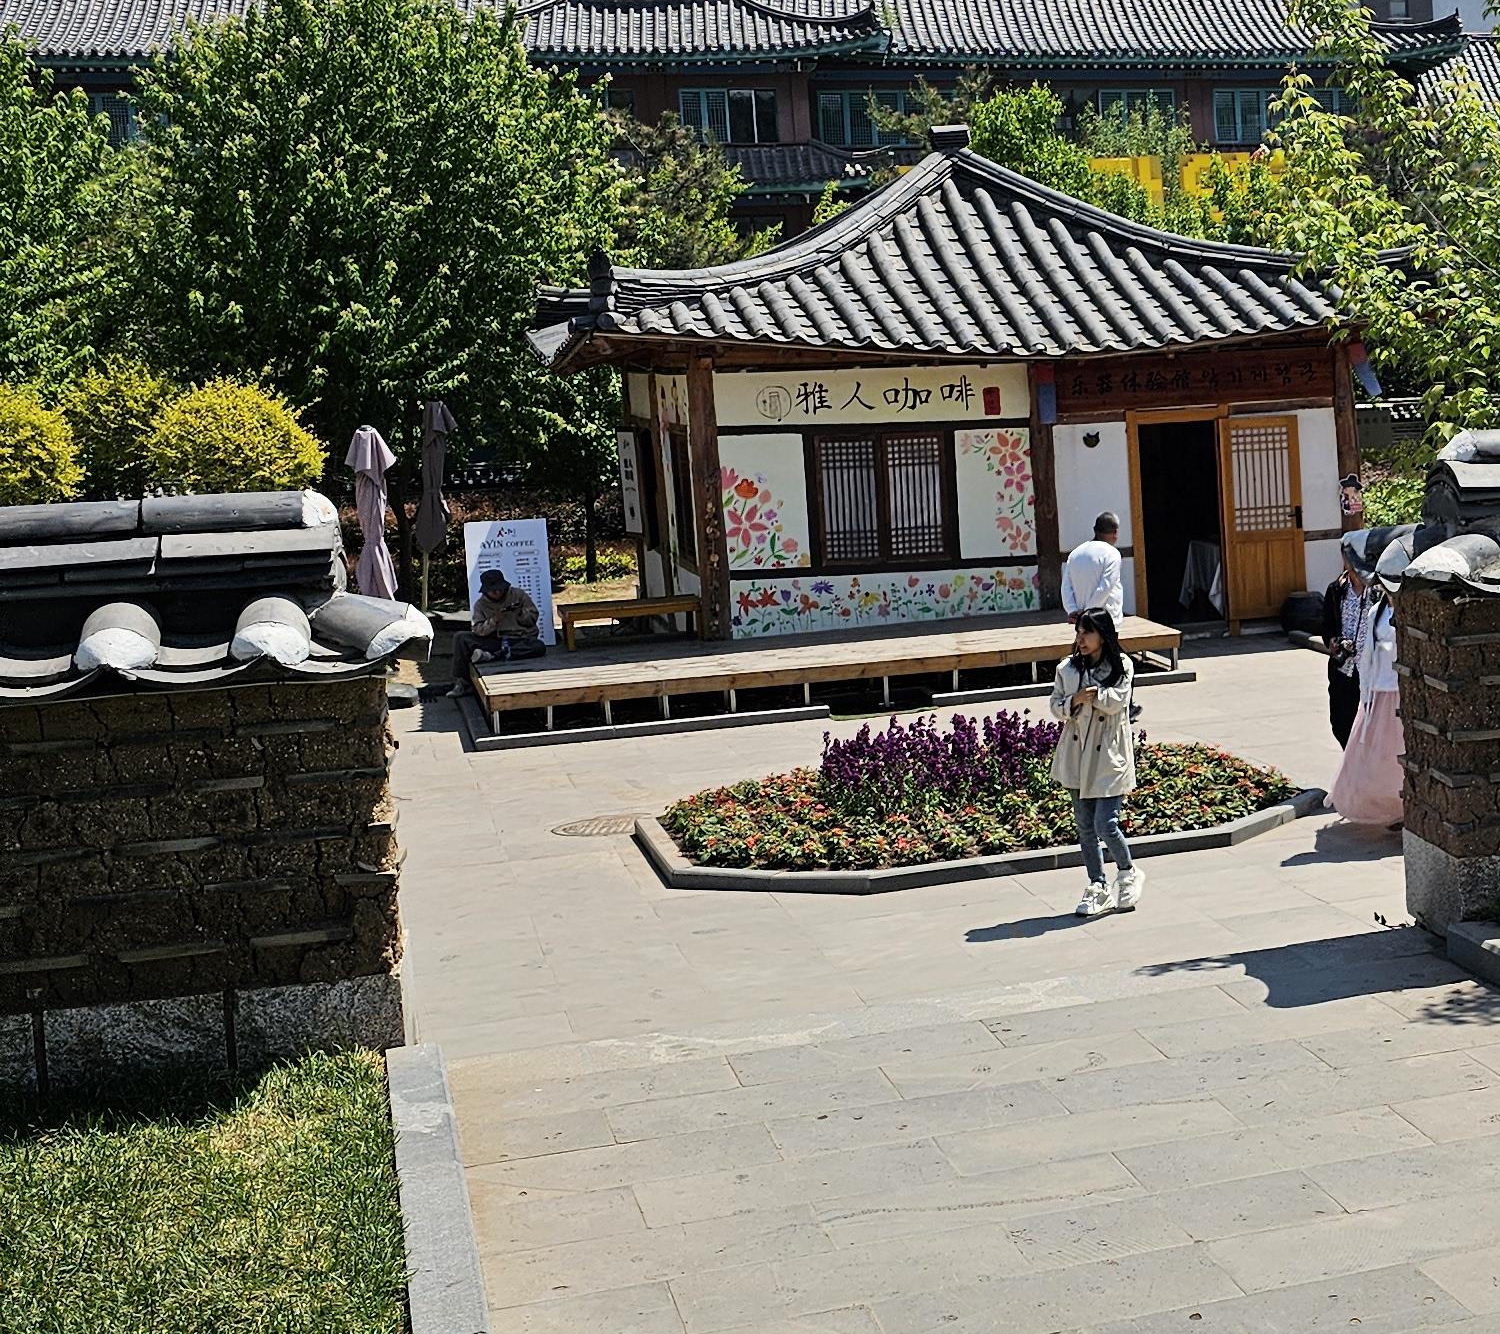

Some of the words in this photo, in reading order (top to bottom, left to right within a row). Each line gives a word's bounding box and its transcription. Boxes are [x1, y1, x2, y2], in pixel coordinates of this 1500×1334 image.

[794, 374, 976, 414] 雅人咖啡
[505, 539, 535, 548] COFFEE
